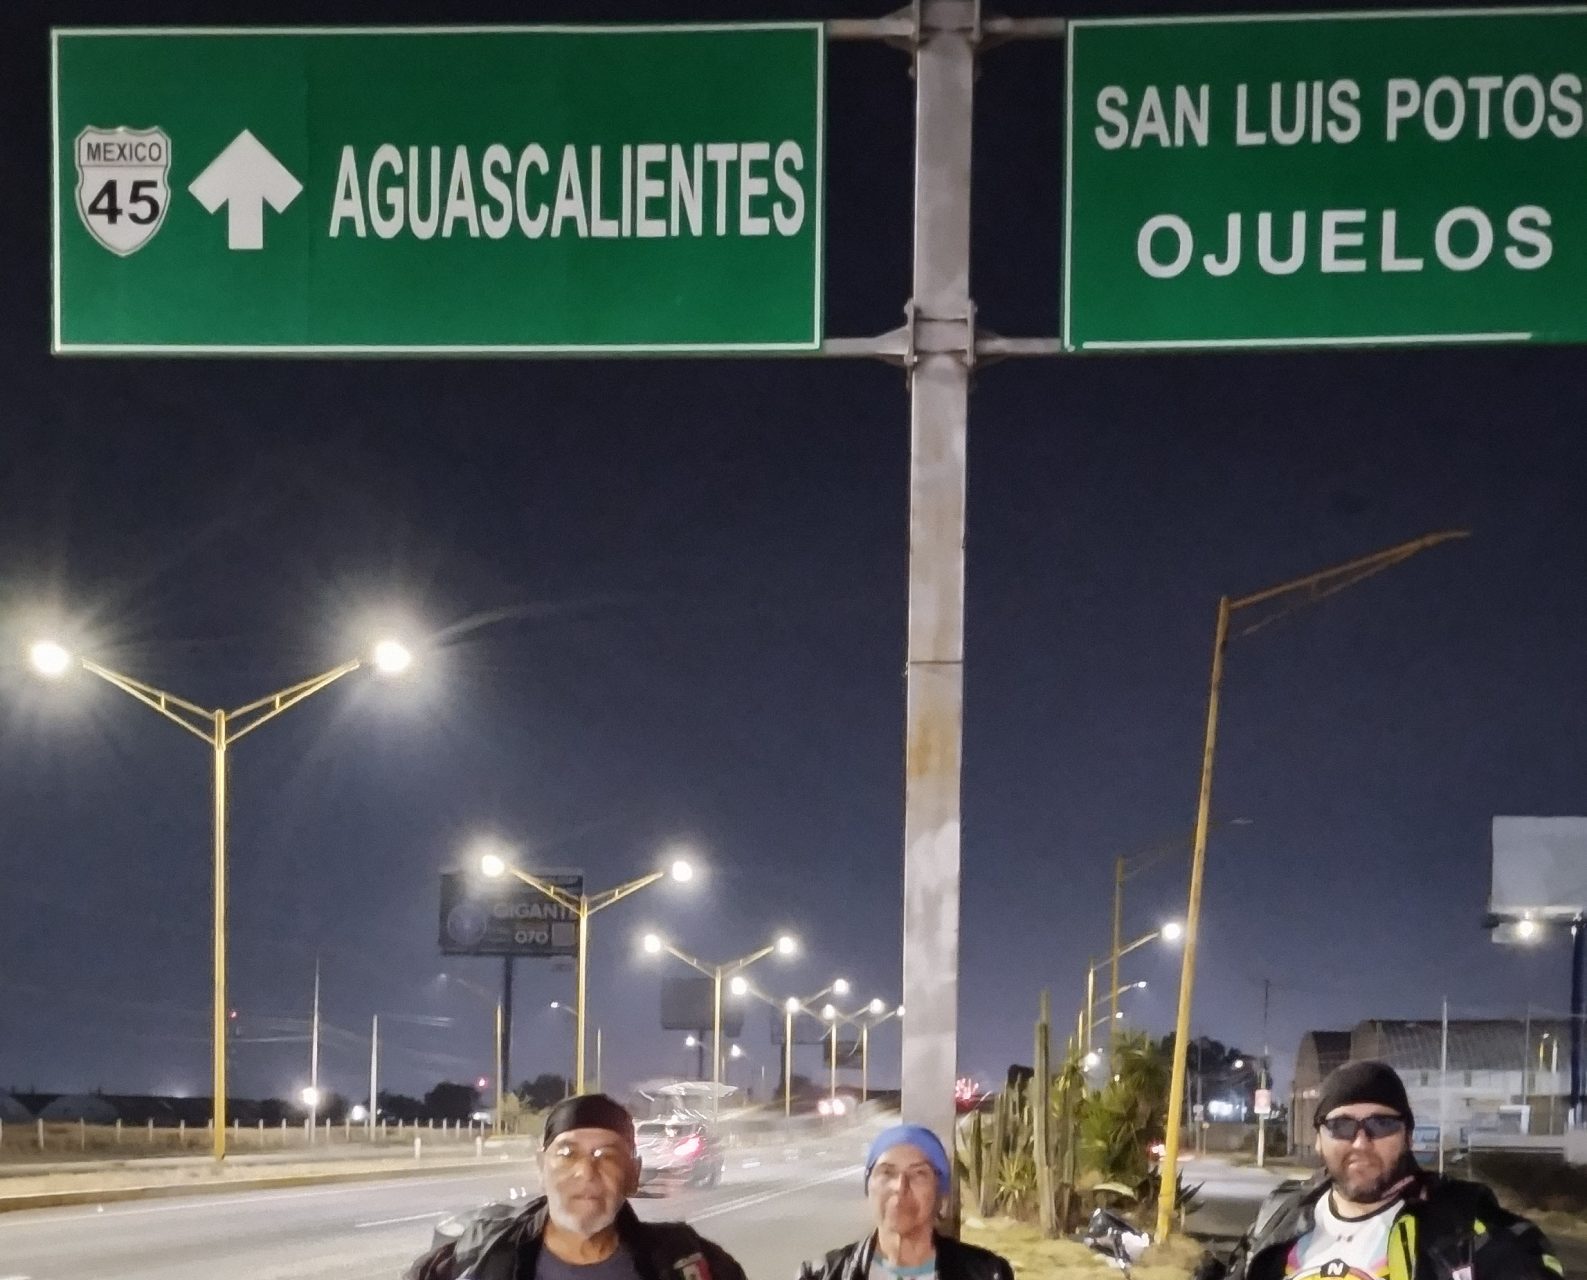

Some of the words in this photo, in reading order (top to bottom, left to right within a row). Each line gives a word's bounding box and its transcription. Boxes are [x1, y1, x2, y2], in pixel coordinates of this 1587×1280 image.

[1095, 84, 1210, 149] SAN
[1236, 79, 1361, 146] LUIS
[1386, 73, 1586, 142] POTOS
[86, 141, 163, 163] MEXICO
[329, 140, 804, 239] AGUASCALIENTES
[87, 179, 161, 225] 45
[1136, 204, 1553, 279] OJUELOS
